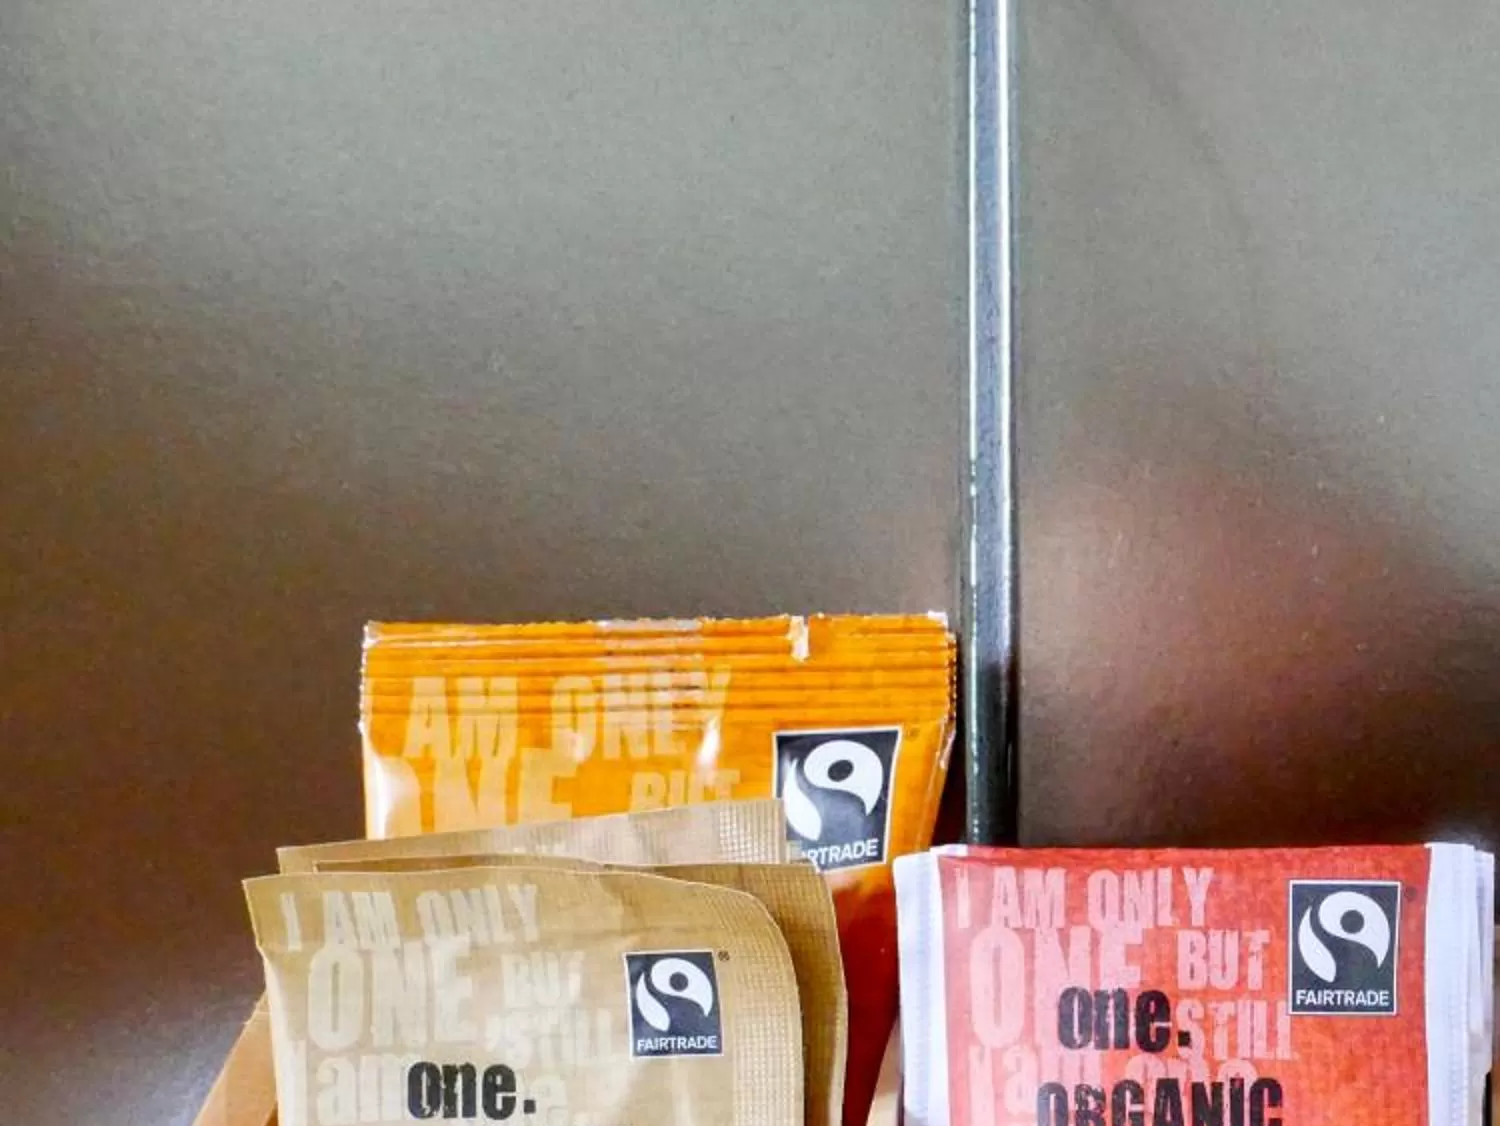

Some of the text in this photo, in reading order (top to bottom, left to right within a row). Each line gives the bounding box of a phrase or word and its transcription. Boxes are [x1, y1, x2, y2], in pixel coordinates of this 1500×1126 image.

[402, 664, 732, 768] AM ONLY
[802, 838, 879, 866] RTRADE
[322, 889, 402, 950] AM
[416, 883, 541, 946] ONLY
[992, 866, 1067, 930] AM
[1087, 867, 1214, 931] ONLY
[1176, 928, 1270, 990] BUT
[1057, 986, 1191, 1053] one.
[1295, 989, 1391, 1007] FAIRTRADE
[636, 1035, 719, 1051] FAIRTRADE
[407, 1060, 537, 1121] one.
